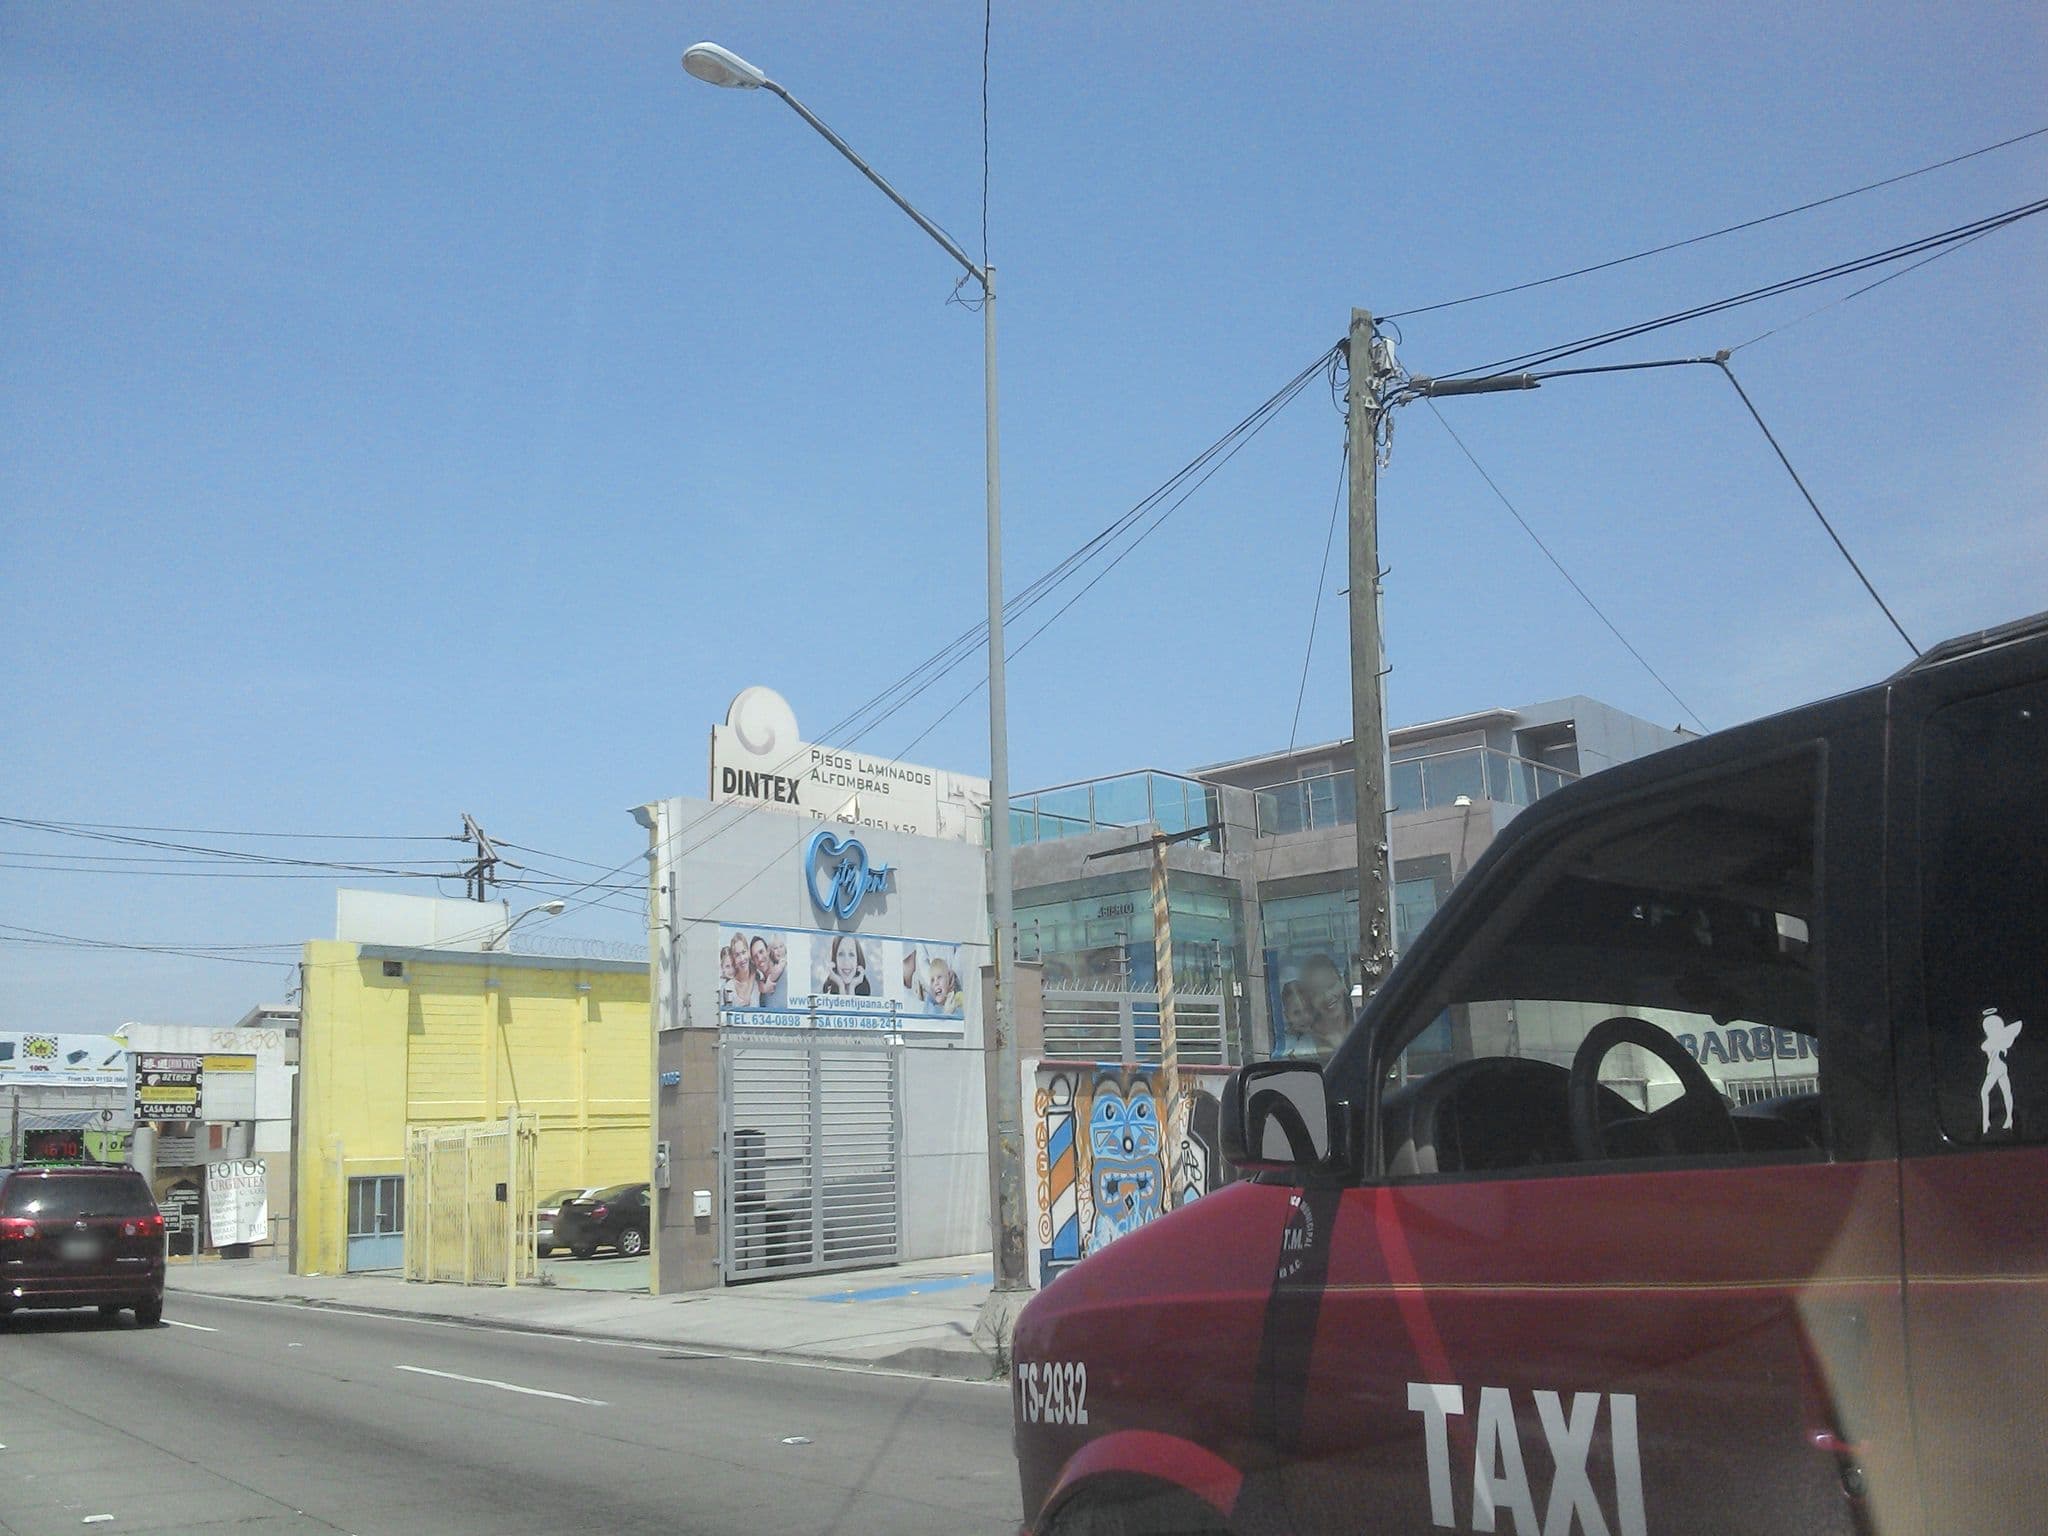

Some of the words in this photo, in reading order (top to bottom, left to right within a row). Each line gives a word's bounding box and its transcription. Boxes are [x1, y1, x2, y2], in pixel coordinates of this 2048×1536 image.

[810, 750, 853, 770] PISOS
[858, 758, 932, 786] LAMINADOS
[722, 766, 800, 805] DINTEX
[810, 767, 890, 795] ALFOMBRAS
[752, 1014, 800, 1027] 634-0898
[812, 1016, 831, 1029] SA
[29, 1064, 49, 1072] 100%
[143, 1105, 164, 1113] CASA
[165, 1105, 174, 1113] de
[175, 1105, 193, 1113] ORO
[208, 1159, 266, 1179] FOTOS
[210, 1176, 265, 1192] URGENTES
[1019, 1362, 1088, 1425] TS-2932
[1407, 1382, 1648, 1536] TAXI
